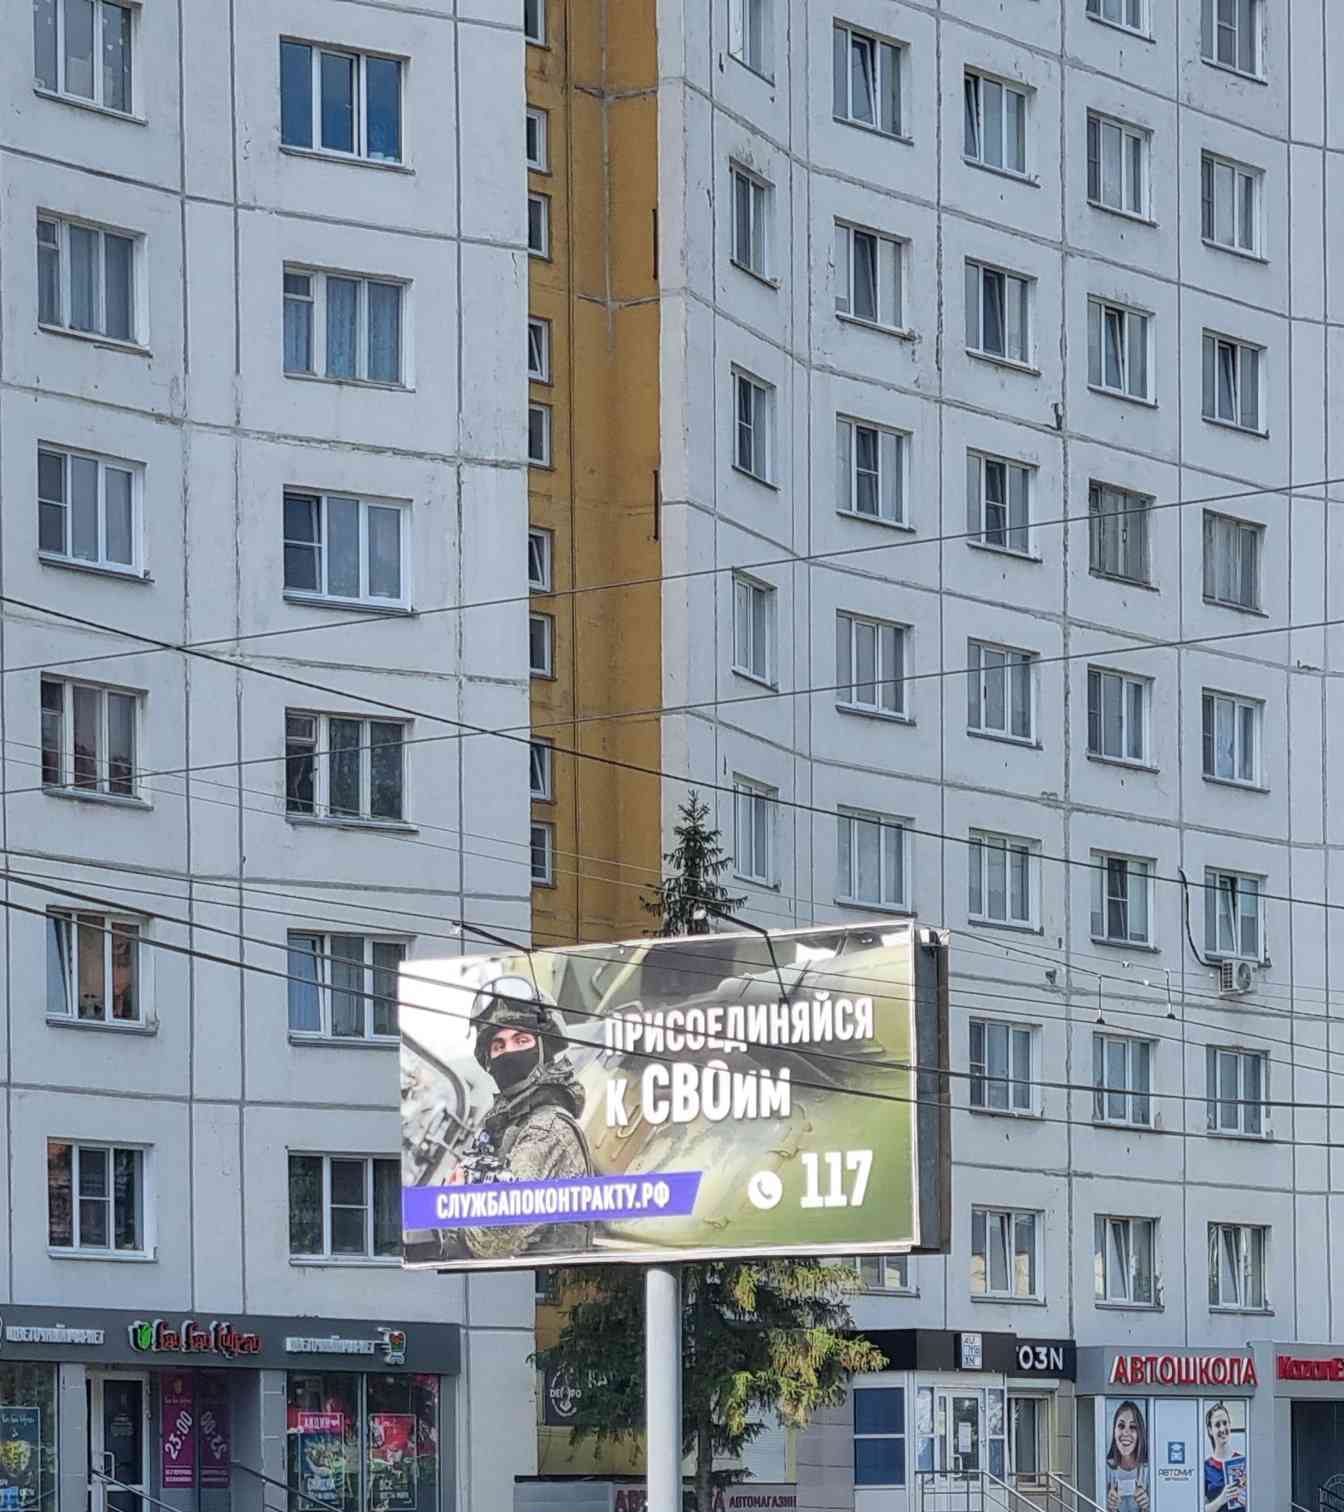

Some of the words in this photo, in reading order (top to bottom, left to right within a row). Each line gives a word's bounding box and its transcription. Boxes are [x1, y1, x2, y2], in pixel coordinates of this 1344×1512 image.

[605, 991, 874, 1056] ПРИСОЕДИНЯЙСЯ
[799, 1149, 874, 1209] 117
[436, 1182, 671, 1220] СЛУЖБАПОКОНТРАКТУ.РФ
[1016, 1345, 1064, 1371] O3N
[1110, 1355, 1258, 1386] АВТОШКОЛА
